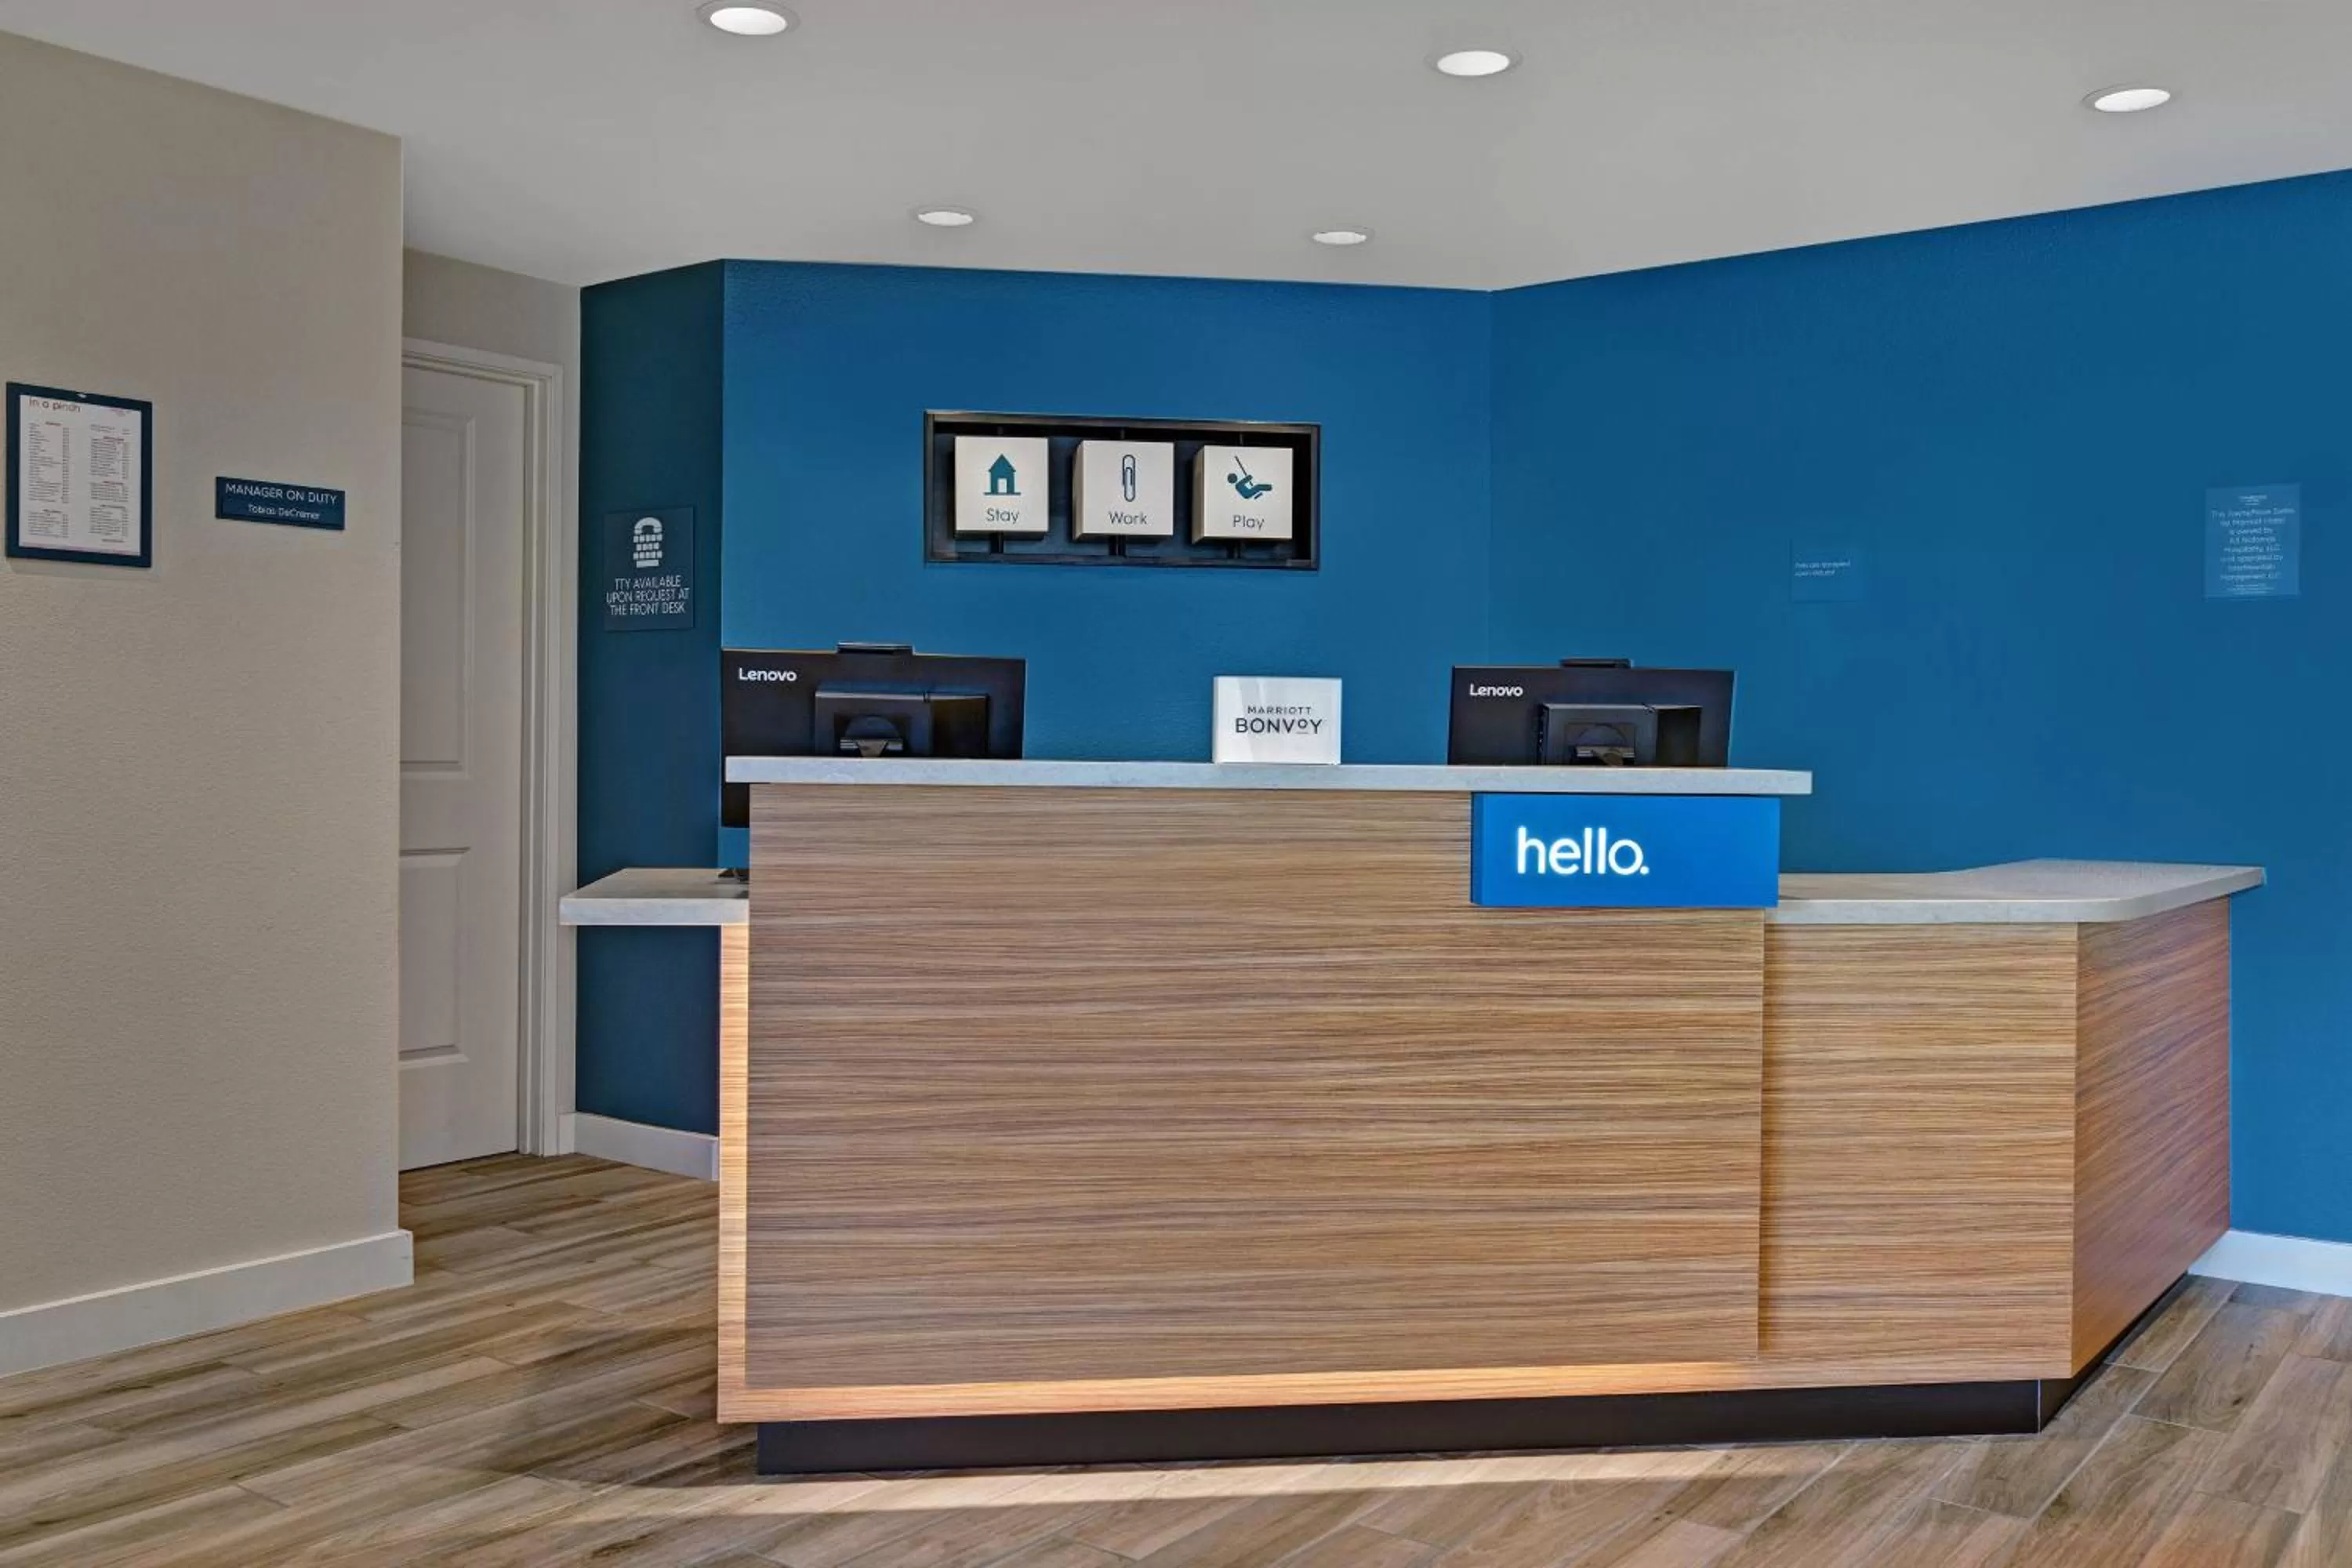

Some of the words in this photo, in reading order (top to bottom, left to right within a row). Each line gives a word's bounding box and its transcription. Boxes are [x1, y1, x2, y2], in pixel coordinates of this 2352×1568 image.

[225, 483, 283, 499] MANAGER
[286, 490, 304, 501] ON
[308, 492, 338, 504] DUTY
[986, 508, 1020, 524] Stay
[1109, 511, 1148, 525] Work
[1232, 514, 1265, 531] Play
[615, 578, 630, 590] TTY
[633, 575, 681, 589] AVAILABLE
[606, 590, 633, 603] UPON
[636, 589, 676, 601] REQUEST
[679, 588, 690, 599] AT
[610, 604, 627, 615] THE
[630, 602, 659, 615] FRONT
[662, 601, 686, 614] DESK
[739, 667, 798, 682] Lenovo
[1469, 683, 1524, 697] Lenovo
[1247, 705, 1312, 715] MARRIOTT
[1236, 717, 1323, 735] BONVOY
[1516, 825, 1650, 876] hello.
